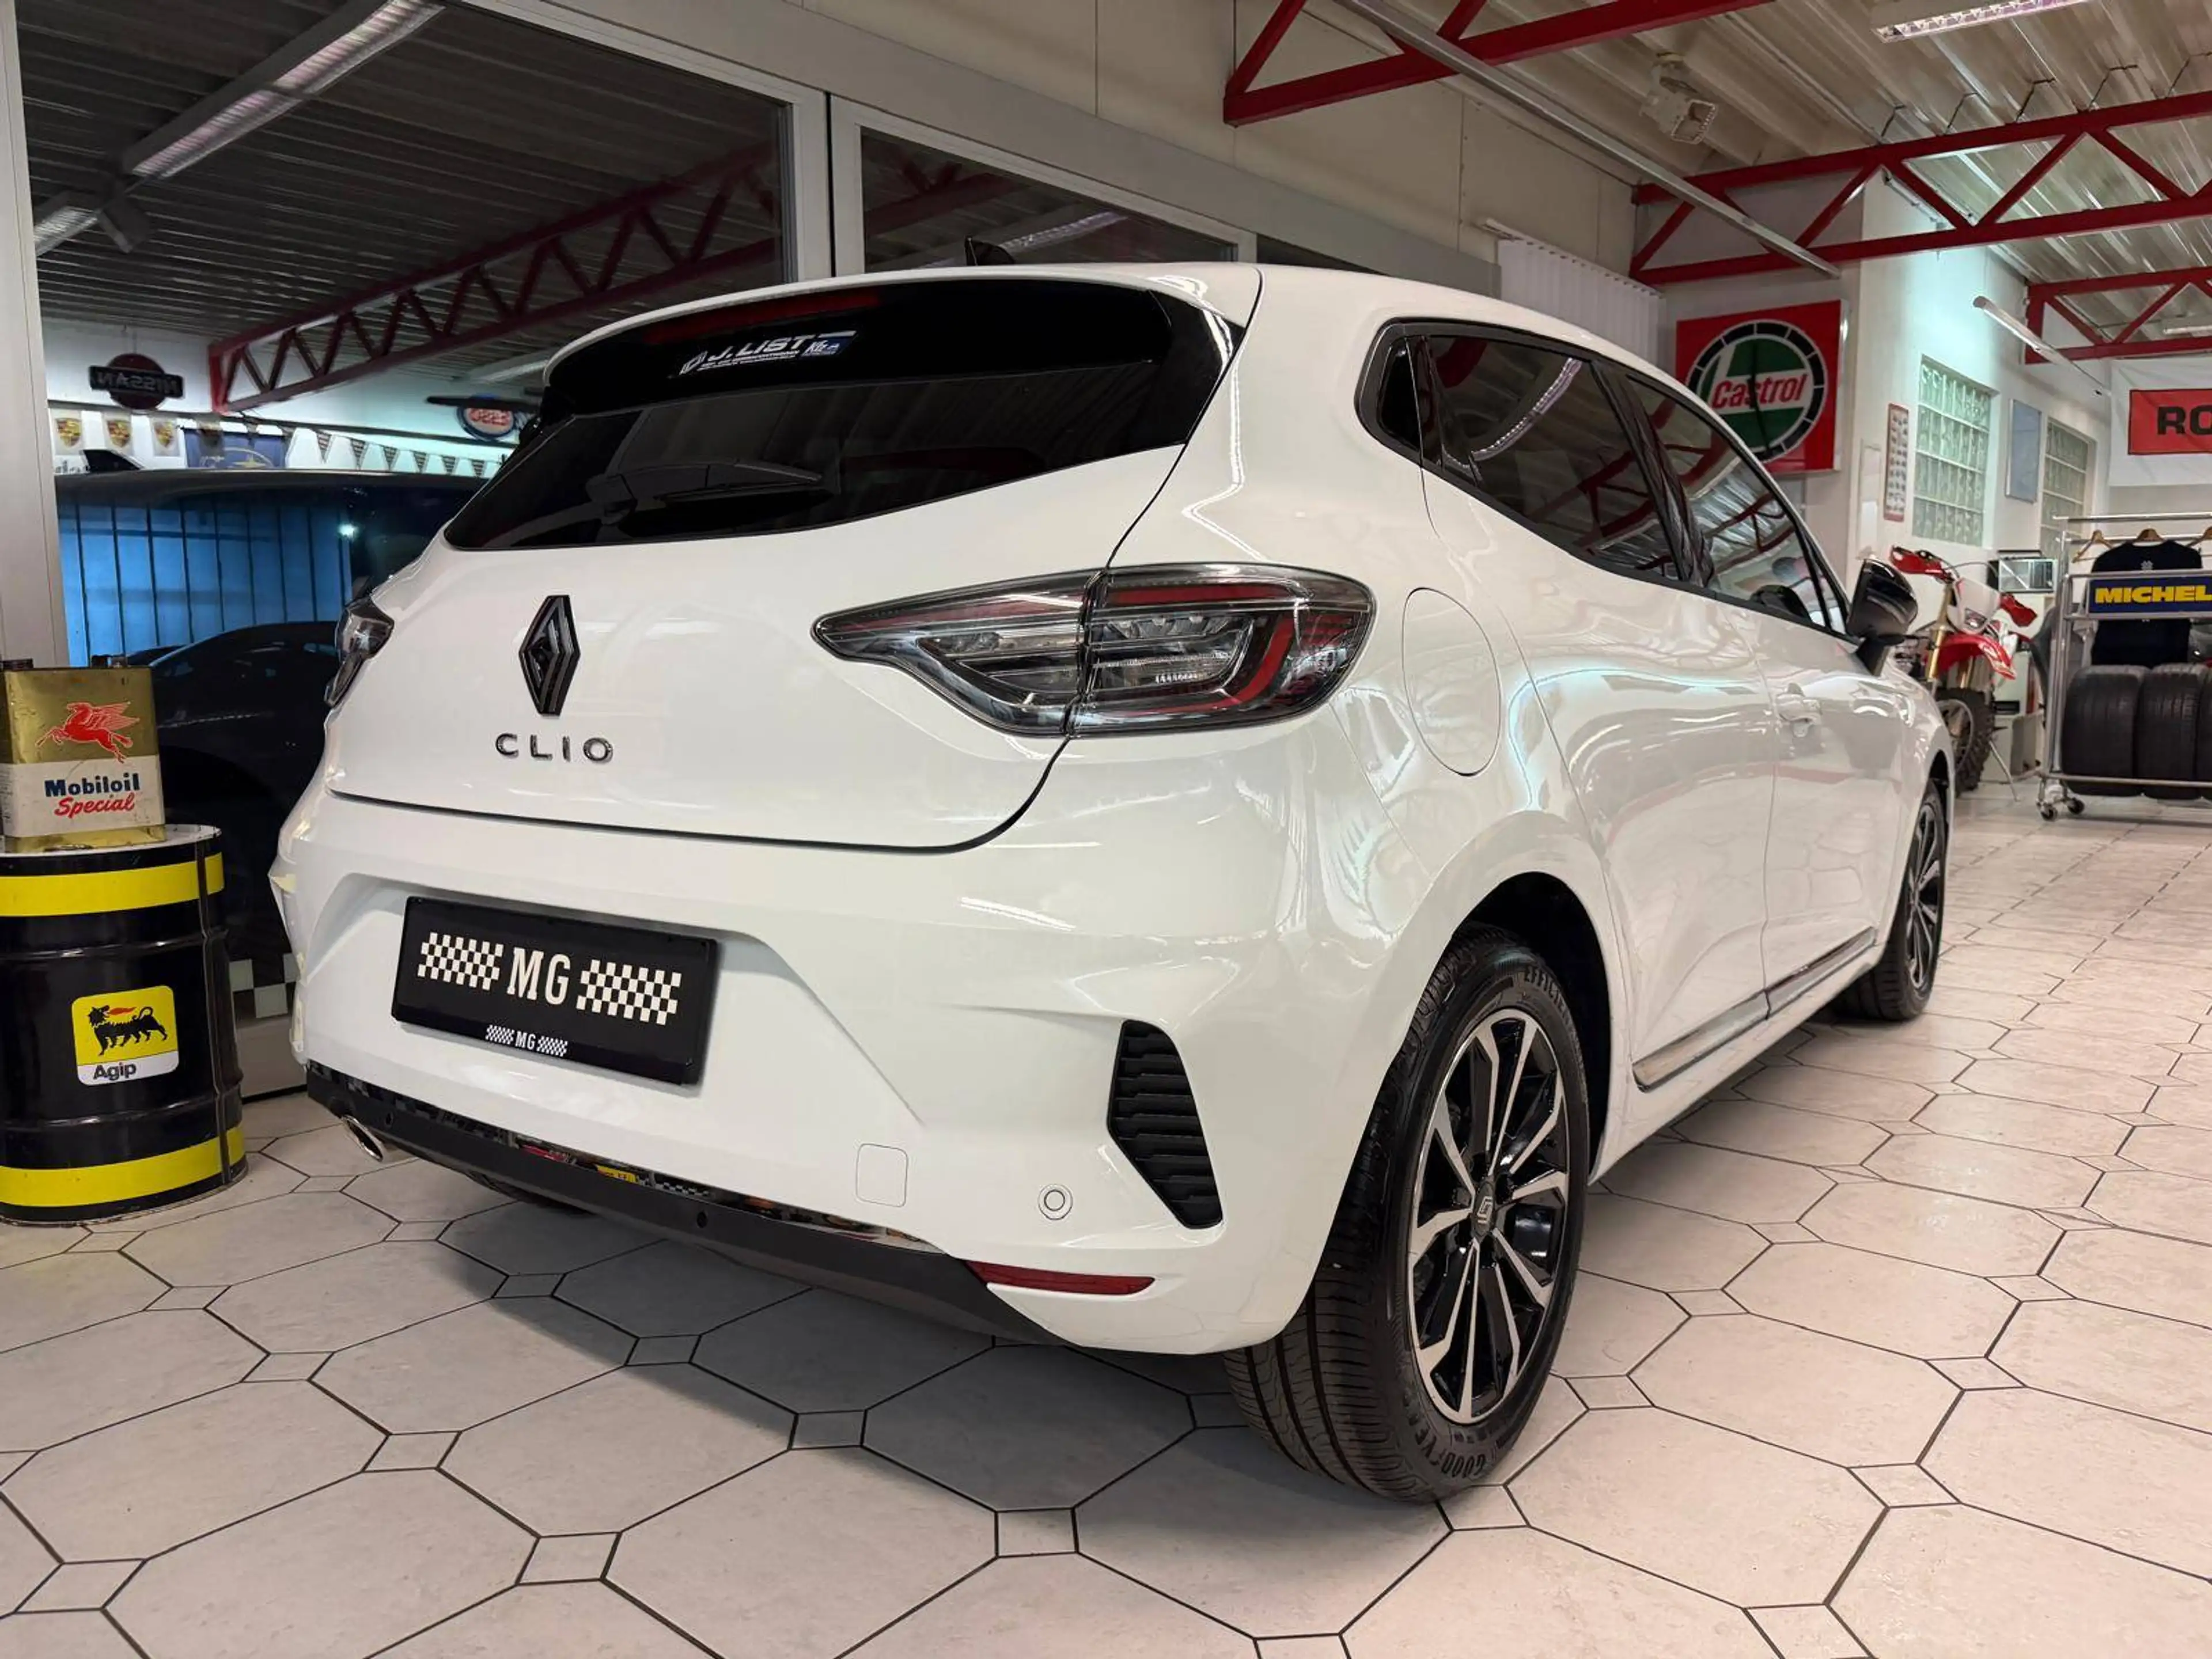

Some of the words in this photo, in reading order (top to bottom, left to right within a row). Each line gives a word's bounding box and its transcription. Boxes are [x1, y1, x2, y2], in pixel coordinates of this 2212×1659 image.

[495, 733, 613, 764] CLIO
[44, 772, 141, 798] Mobiloil
[54, 791, 136, 819] Special
[506, 946, 571, 1006] MG
[515, 1030, 537, 1051] MG
[92, 1061, 138, 1081] Agip
